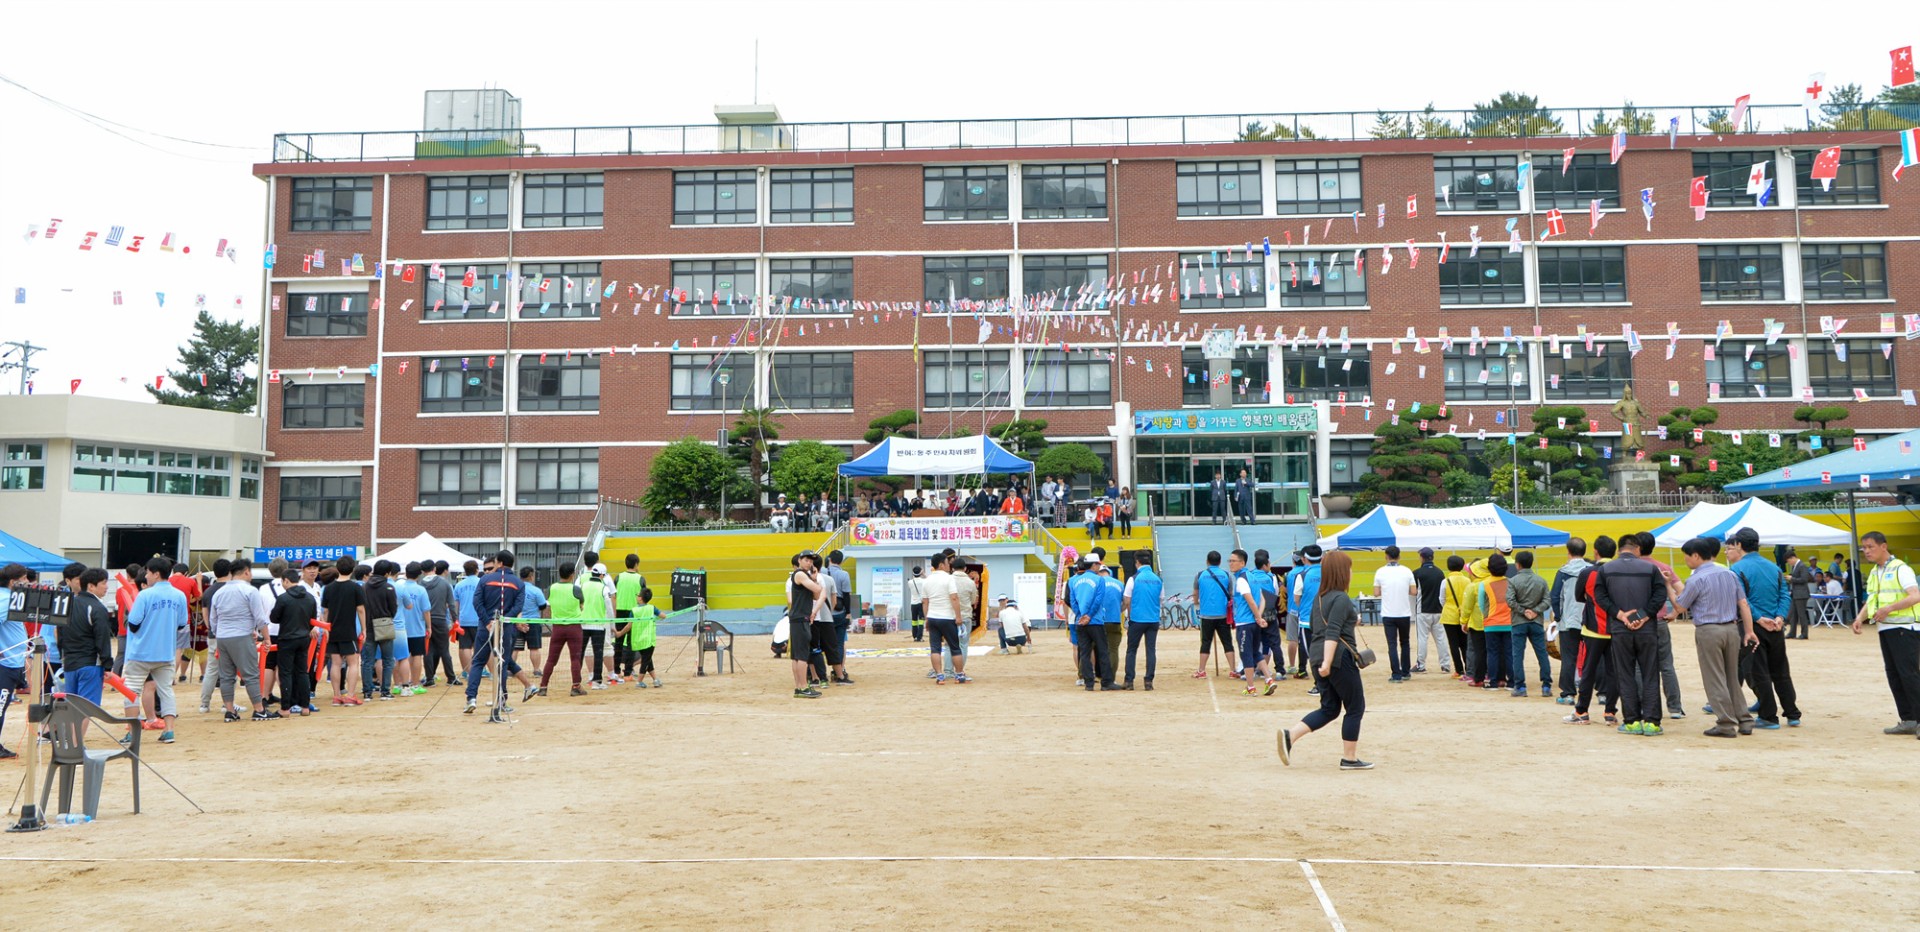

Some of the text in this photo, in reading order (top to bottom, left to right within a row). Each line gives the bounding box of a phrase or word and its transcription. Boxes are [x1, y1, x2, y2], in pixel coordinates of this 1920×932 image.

[1152, 412, 1310, 429] 사랑과 꿈을 가꾸는 행복한 배움터
[1413, 518, 1442, 526] 해운대구
[1473, 517, 1496, 526] 청년회
[874, 526, 997, 541] 제28차 체육대회 및 회원가족 한마당
[9, 591, 70, 615] 20 11
